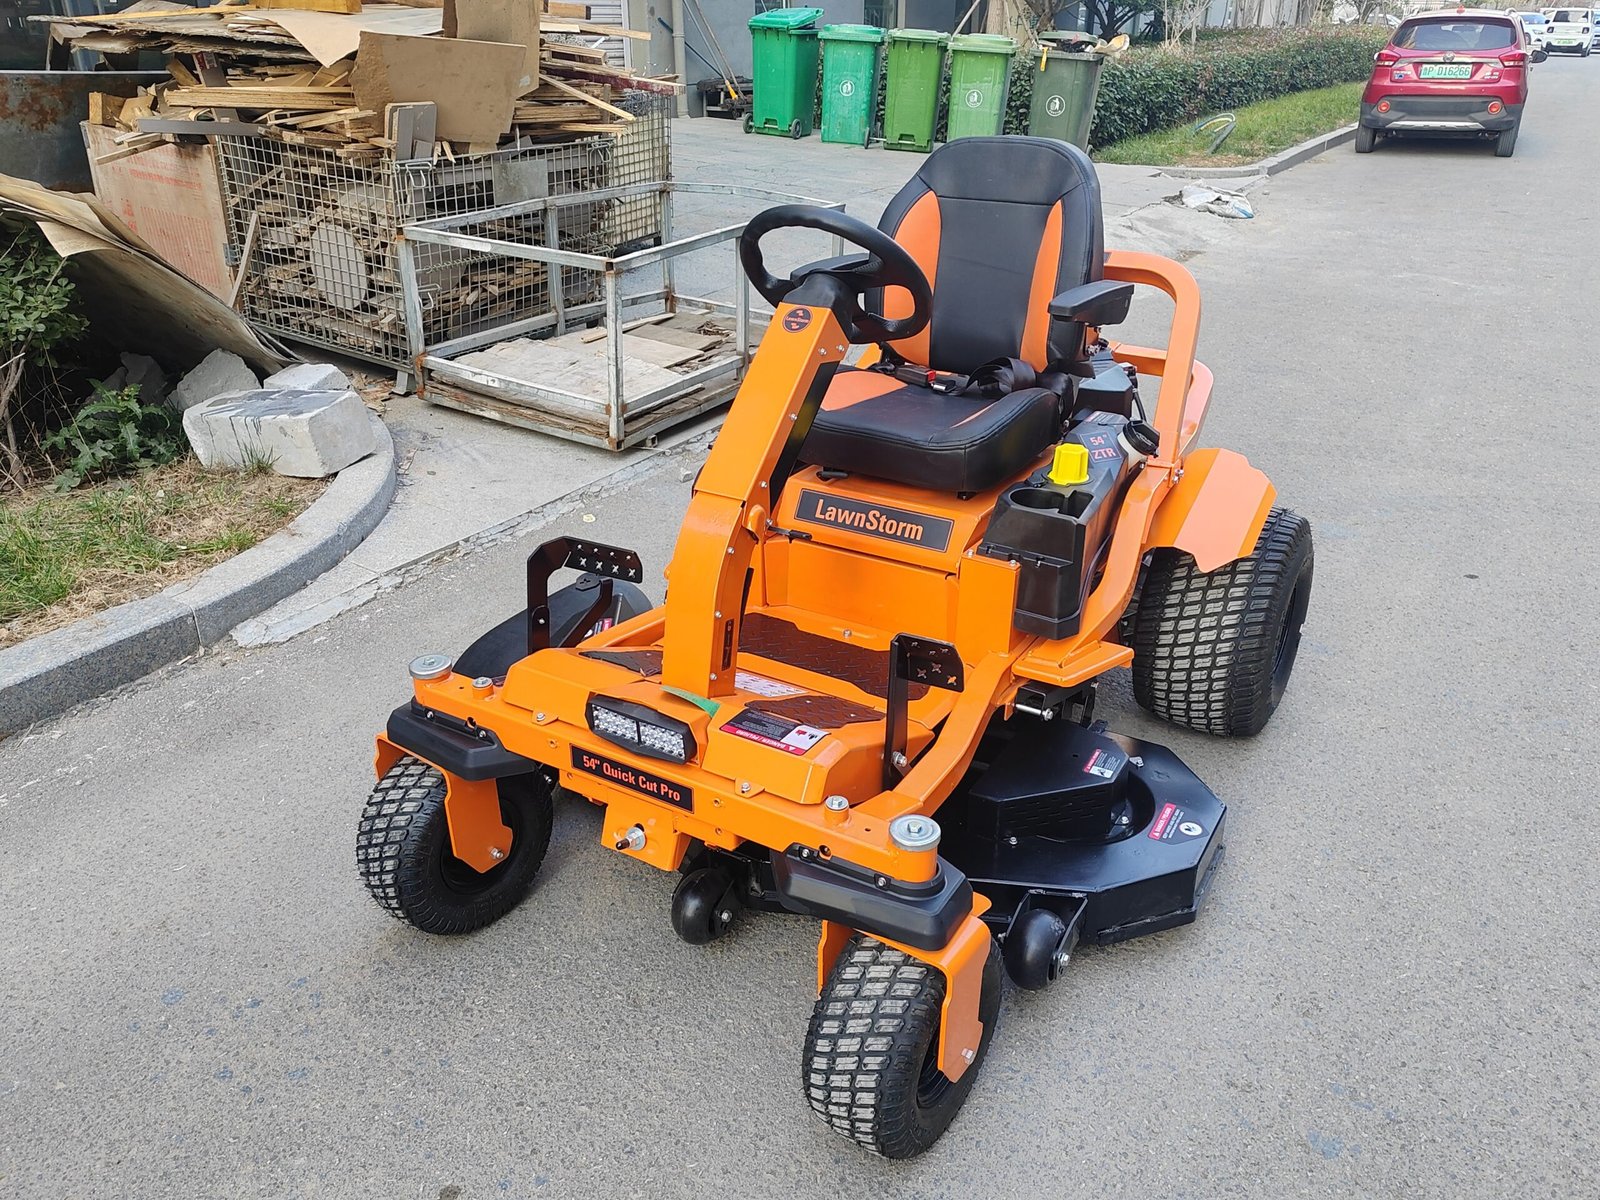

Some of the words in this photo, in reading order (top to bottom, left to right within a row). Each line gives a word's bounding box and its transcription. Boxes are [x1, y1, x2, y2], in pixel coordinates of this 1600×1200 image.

[1091, 448, 1116, 460] ZTR
[815, 499, 924, 541] LawnStorm
[583, 755, 600, 770] 54"
[603, 762, 636, 785] Quick
[638, 776, 658, 793] Cut
[660, 783, 681, 801] Pro
